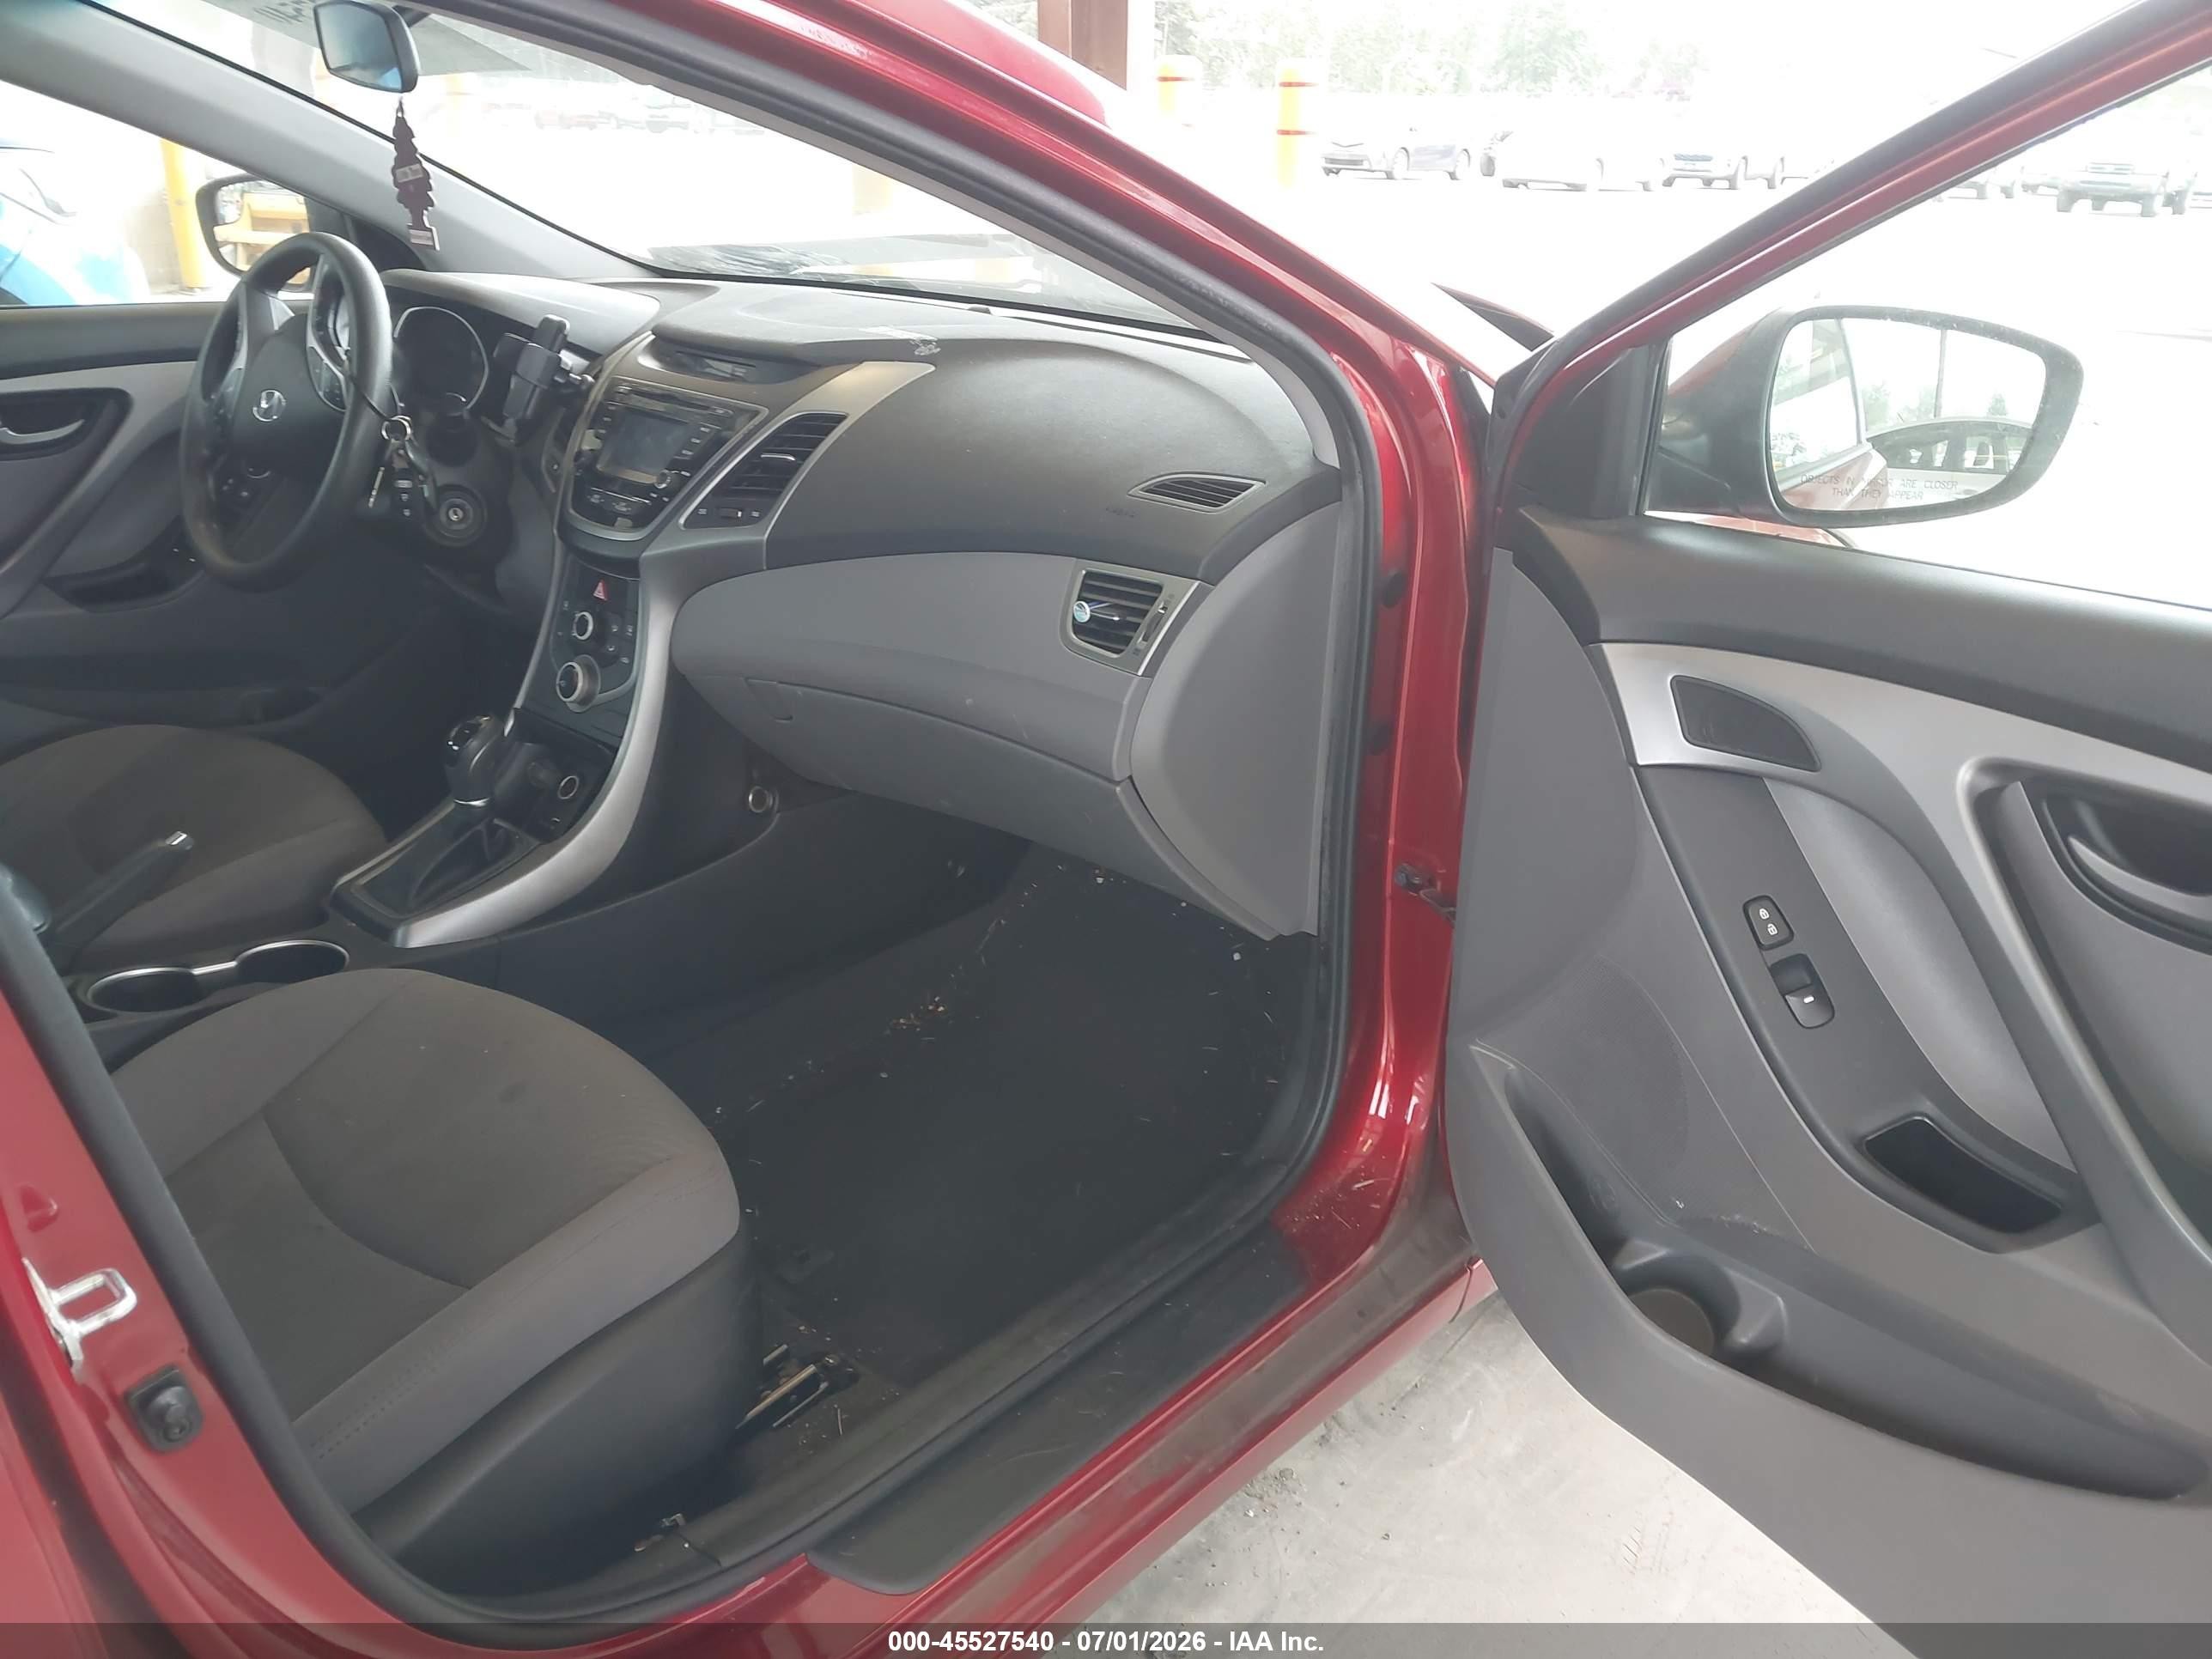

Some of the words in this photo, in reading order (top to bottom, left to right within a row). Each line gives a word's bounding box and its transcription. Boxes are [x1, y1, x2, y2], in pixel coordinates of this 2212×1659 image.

[1801, 474, 1840, 484] OBJECTS
[1845, 476, 1855, 485] IN
[1900, 478, 1917, 489] ARE
[1924, 481, 1959, 490] CLOSER
[1832, 487, 1855, 496] THAN
[1890, 490, 1924, 500] APPEAR
